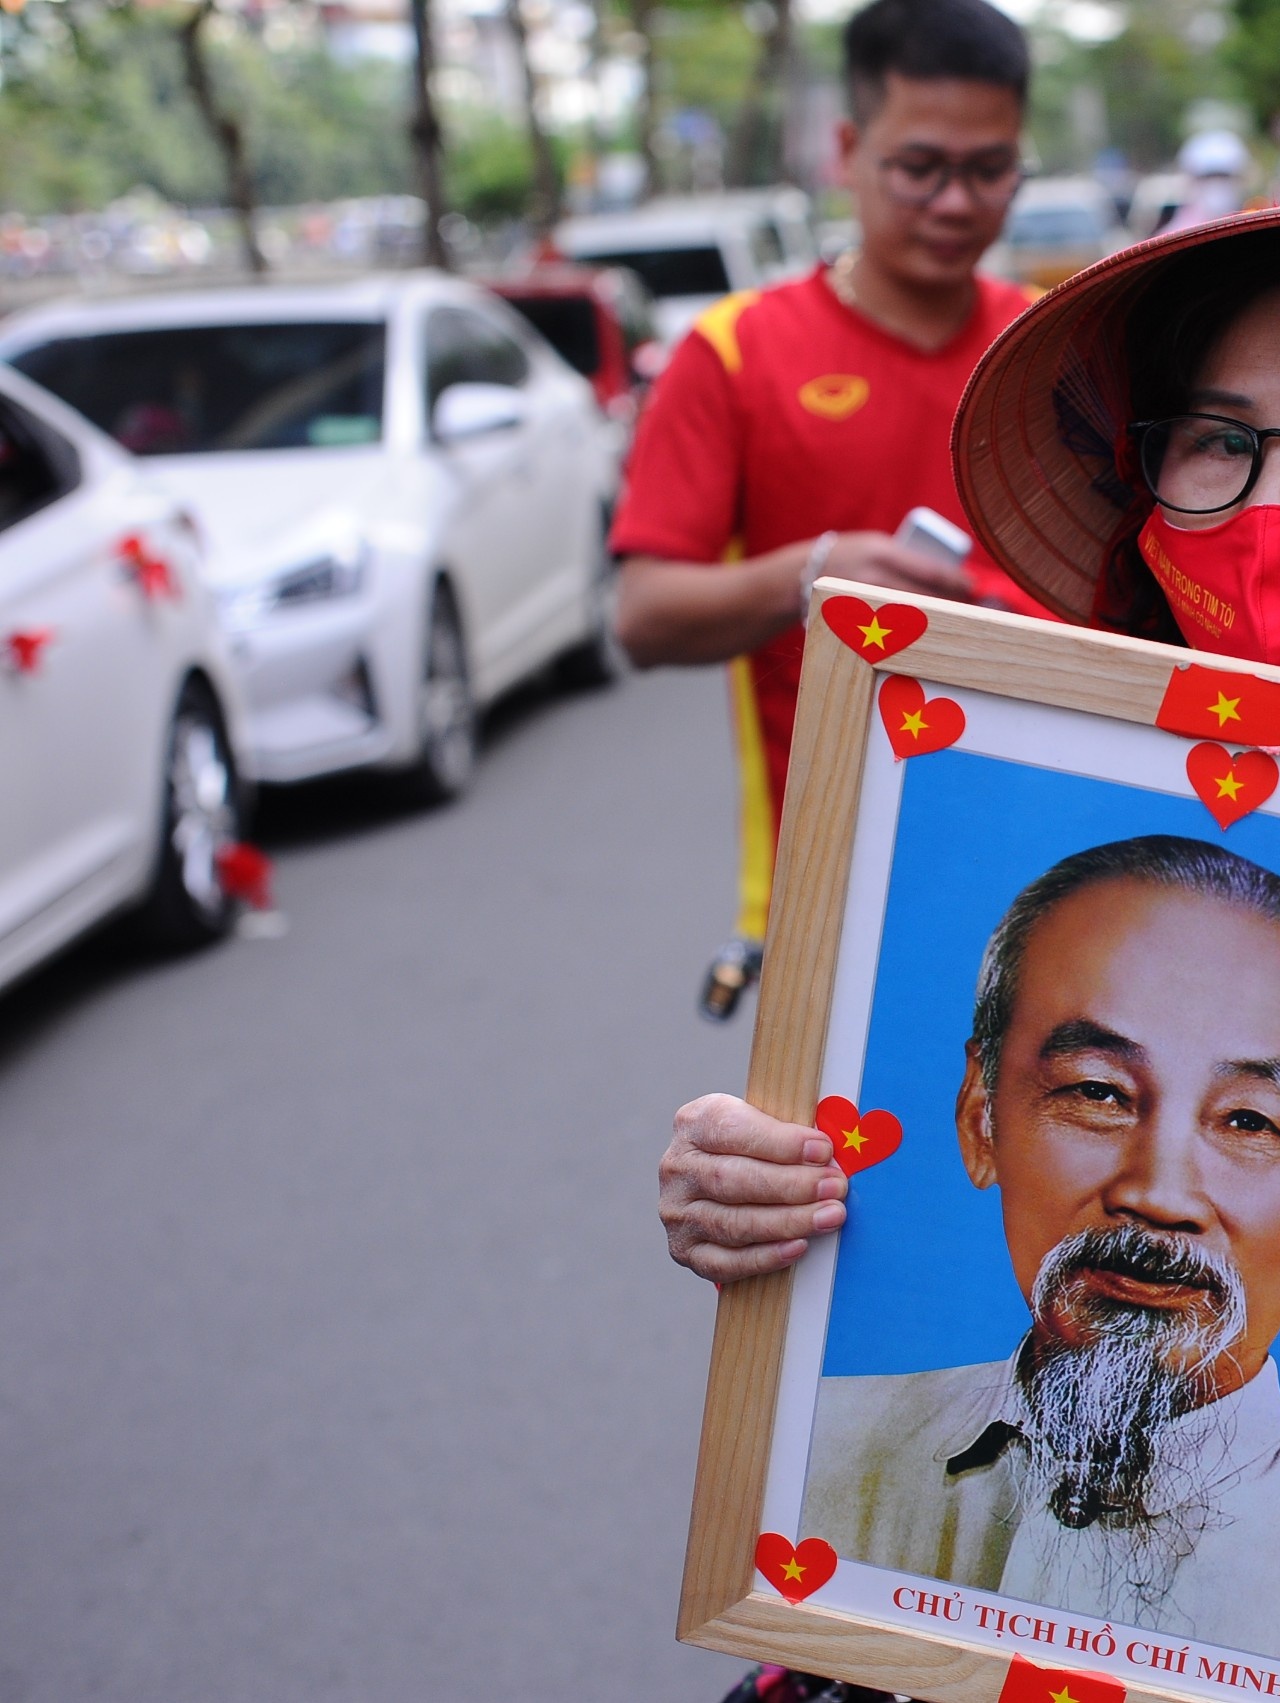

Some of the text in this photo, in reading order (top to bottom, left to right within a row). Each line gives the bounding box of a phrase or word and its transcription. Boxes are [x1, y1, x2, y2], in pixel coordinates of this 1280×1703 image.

[1171, 566, 1202, 604] TRONG
[1202, 588, 1219, 617] TIM
[1219, 602, 1236, 630] TÔI
[893, 1586, 964, 1622] CHỦ
[974, 1604, 1058, 1644] TỊCH
[1066, 1623, 1117, 1657] HỒ
[1126, 1641, 1190, 1675] CHÍ
